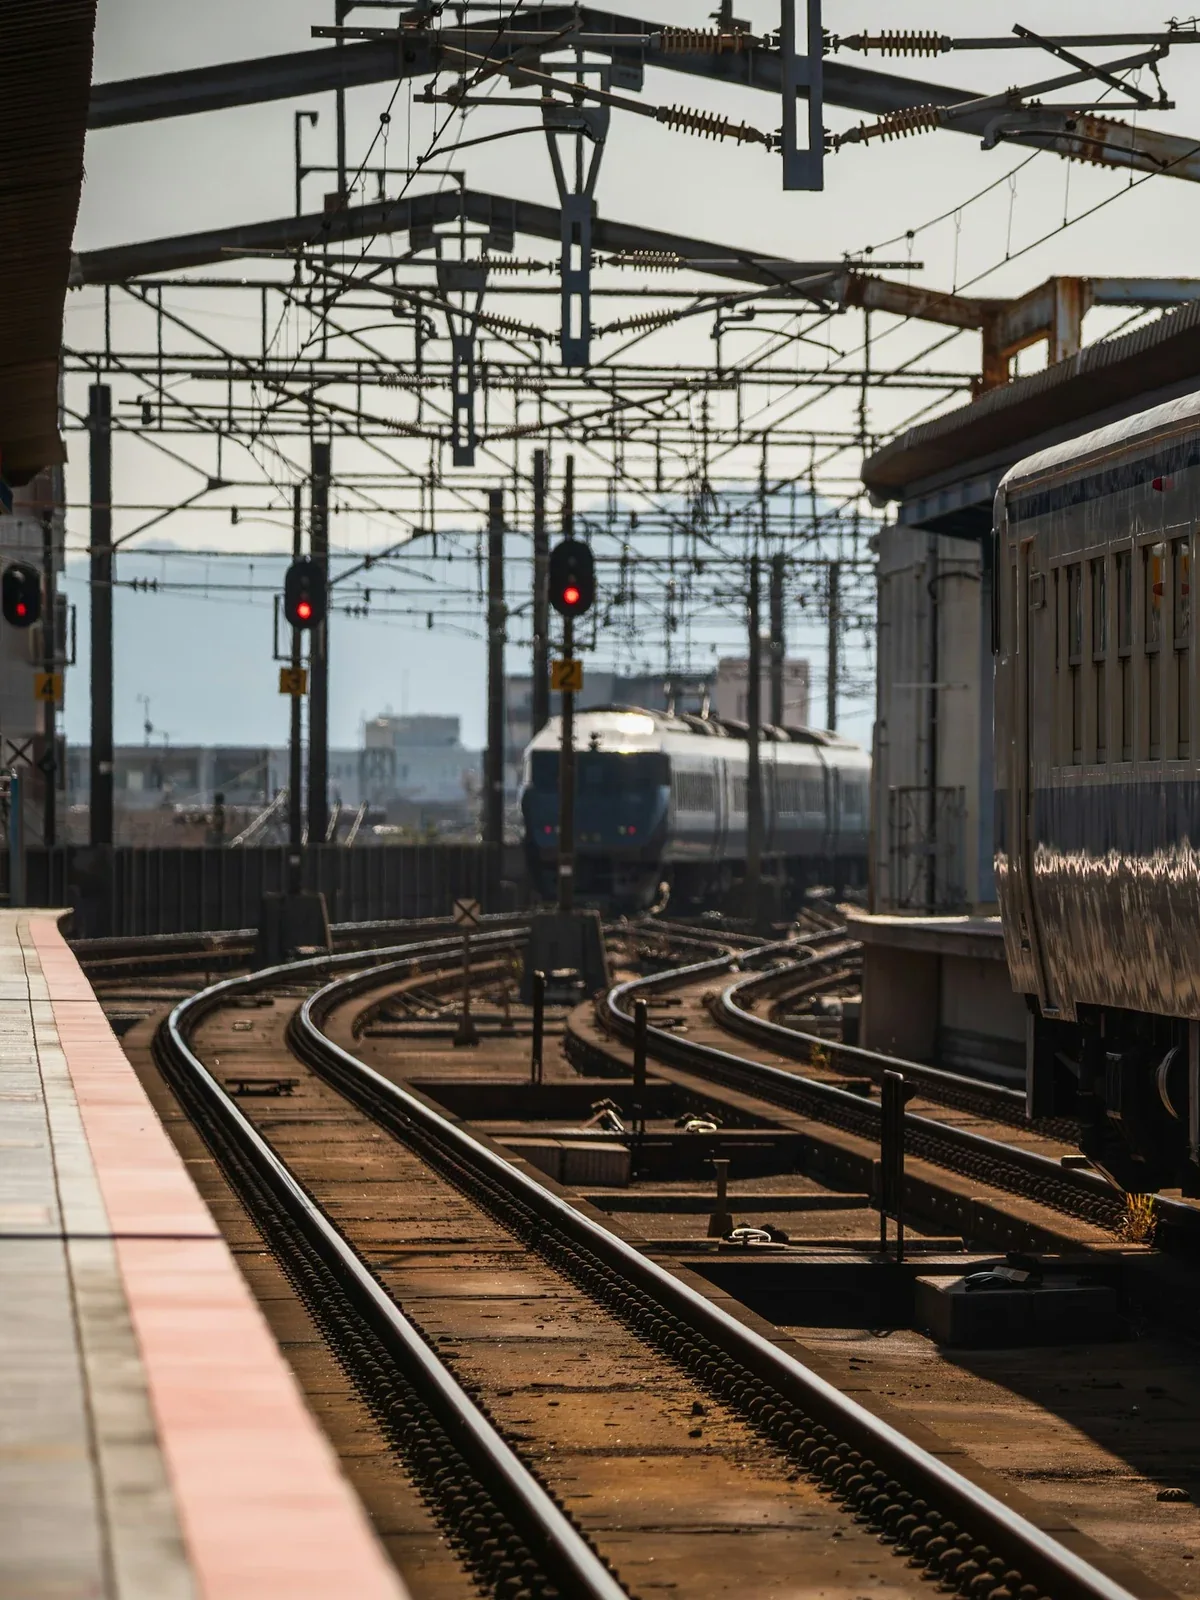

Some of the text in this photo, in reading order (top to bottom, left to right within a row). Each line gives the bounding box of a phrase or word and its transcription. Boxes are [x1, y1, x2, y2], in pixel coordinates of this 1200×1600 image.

[41, 676, 54, 695] 4
[286, 670, 301, 693] 3
[559, 661, 576, 687] 2
